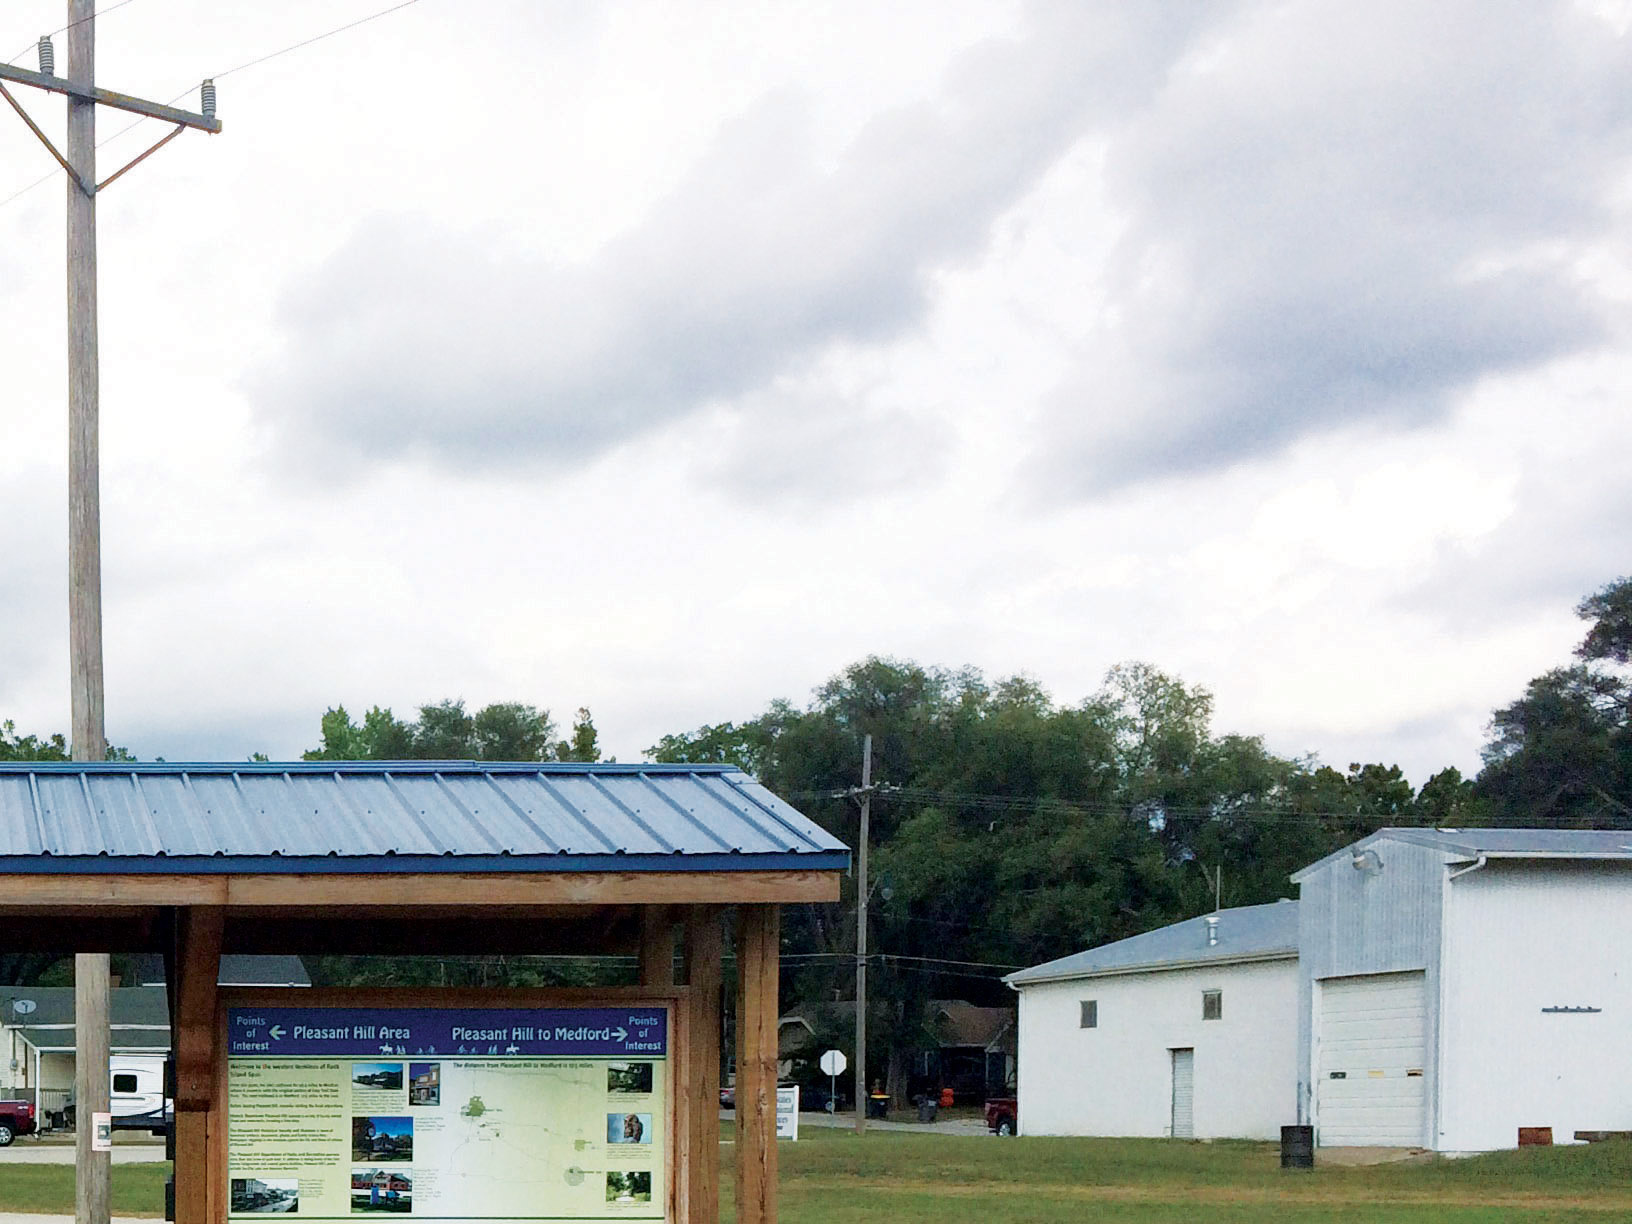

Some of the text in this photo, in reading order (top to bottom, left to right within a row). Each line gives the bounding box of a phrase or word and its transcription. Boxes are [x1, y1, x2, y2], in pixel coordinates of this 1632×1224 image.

[236, 1016, 266, 1026] Points
[628, 1016, 658, 1026] Points
[246, 1028, 256, 1038] of
[294, 1026, 410, 1040] Pleasant Hill Area
[452, 1027, 610, 1041] Pleasant Hill to Medford
[638, 1028, 648, 1038] of
[233, 1041, 270, 1051] Interest
[625, 1041, 661, 1051] Interest
